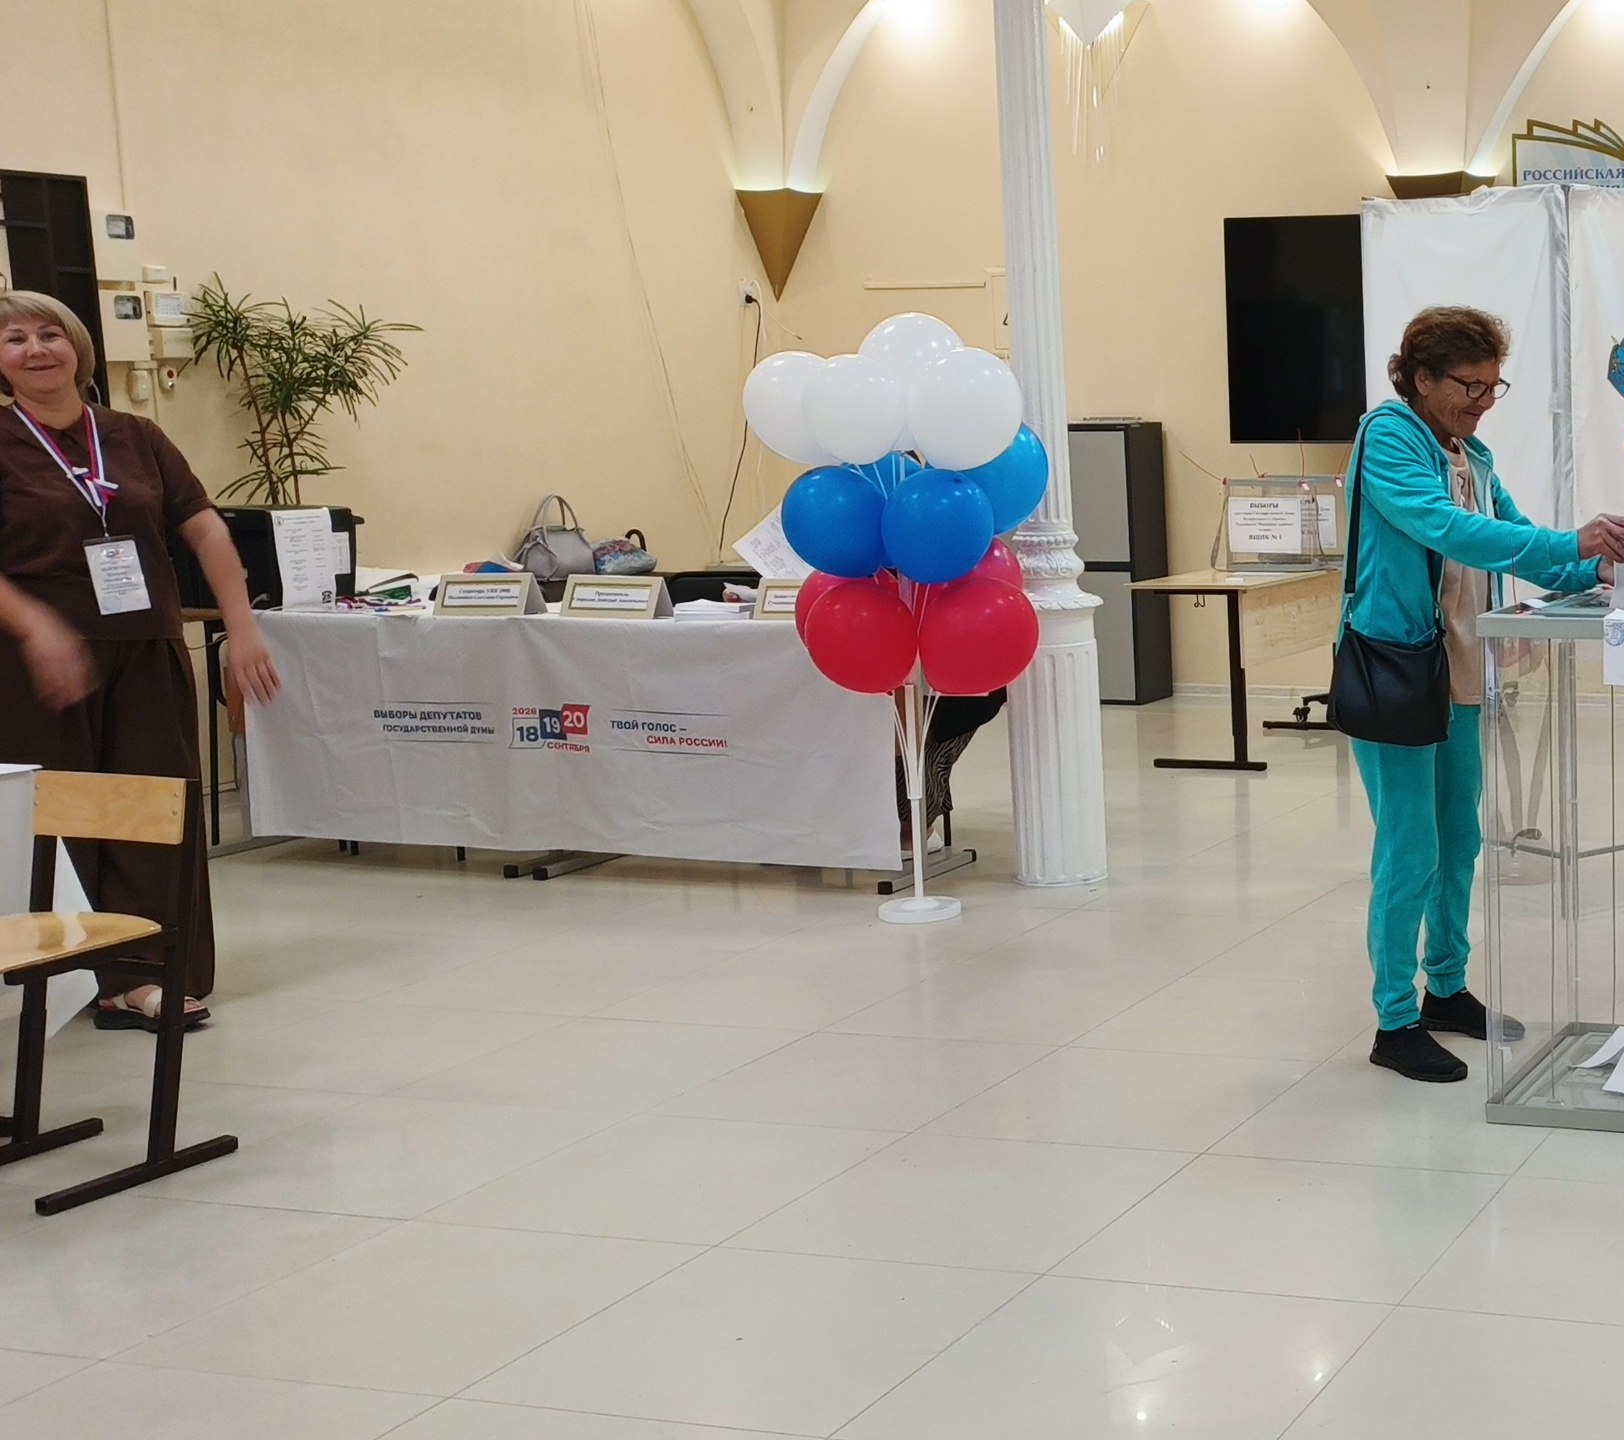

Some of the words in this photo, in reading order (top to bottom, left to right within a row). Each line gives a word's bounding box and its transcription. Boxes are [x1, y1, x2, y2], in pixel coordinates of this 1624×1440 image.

[1523, 167, 1624, 181] РОССИЙСКАЯ
[373, 709, 417, 719] ВЫБОРЫ
[420, 711, 482, 721] ДЕПУТАТОВ
[512, 707, 537, 715] 2026
[382, 724, 469, 734] ГОСУДАРСТВЕННОЙ
[470, 726, 495, 735] ДУМЫ
[517, 726, 539, 742] 18
[542, 716, 561, 734] 19
[562, 711, 585, 728] 20
[610, 720, 639, 730] ТВОЙ
[641, 722, 677, 733] ГОЛОС
[547, 741, 590, 753] СЕНТЯБРЯ
[646, 735, 676, 745] СИЛА
[679, 737, 728, 748] РОССИИ!
